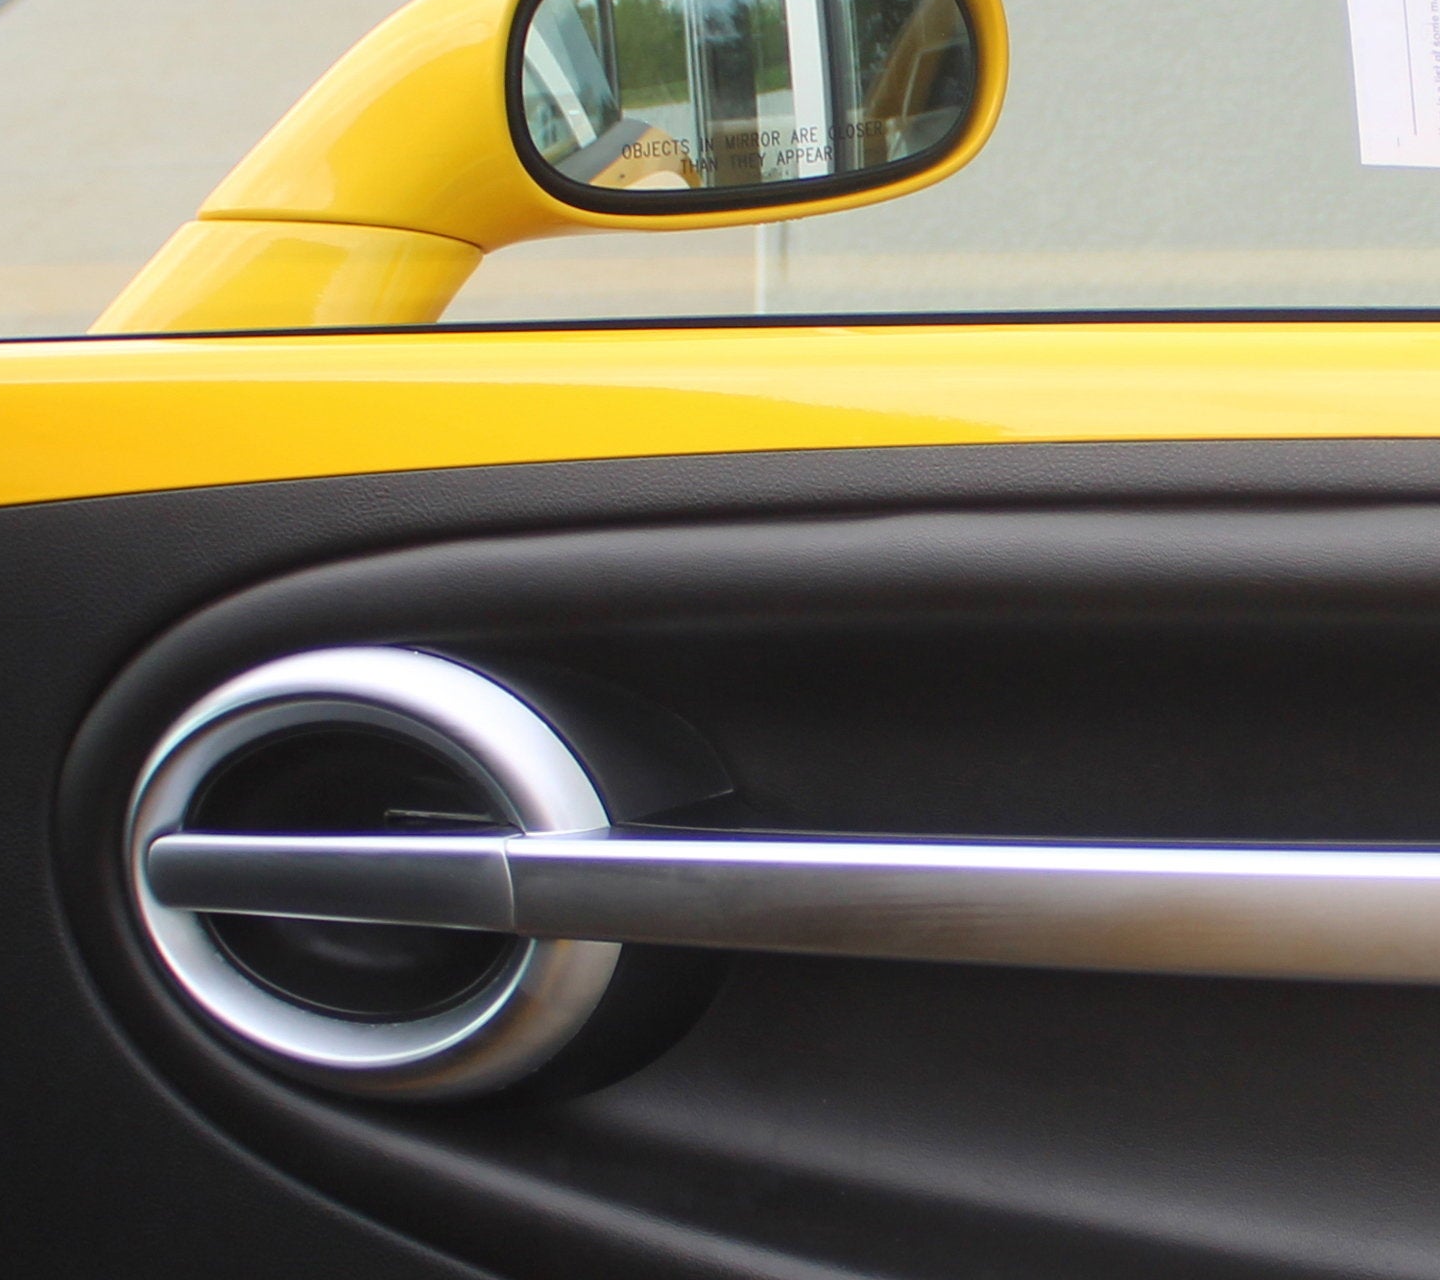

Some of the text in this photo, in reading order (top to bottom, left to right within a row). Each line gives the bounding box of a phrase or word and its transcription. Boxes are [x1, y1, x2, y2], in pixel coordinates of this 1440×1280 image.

[1428, 15, 1440, 46] some
[621, 121, 883, 160] OBJECTS IN MIRROR ARE CLOSER
[680, 146, 834, 174] THAN THEY APPEAR
